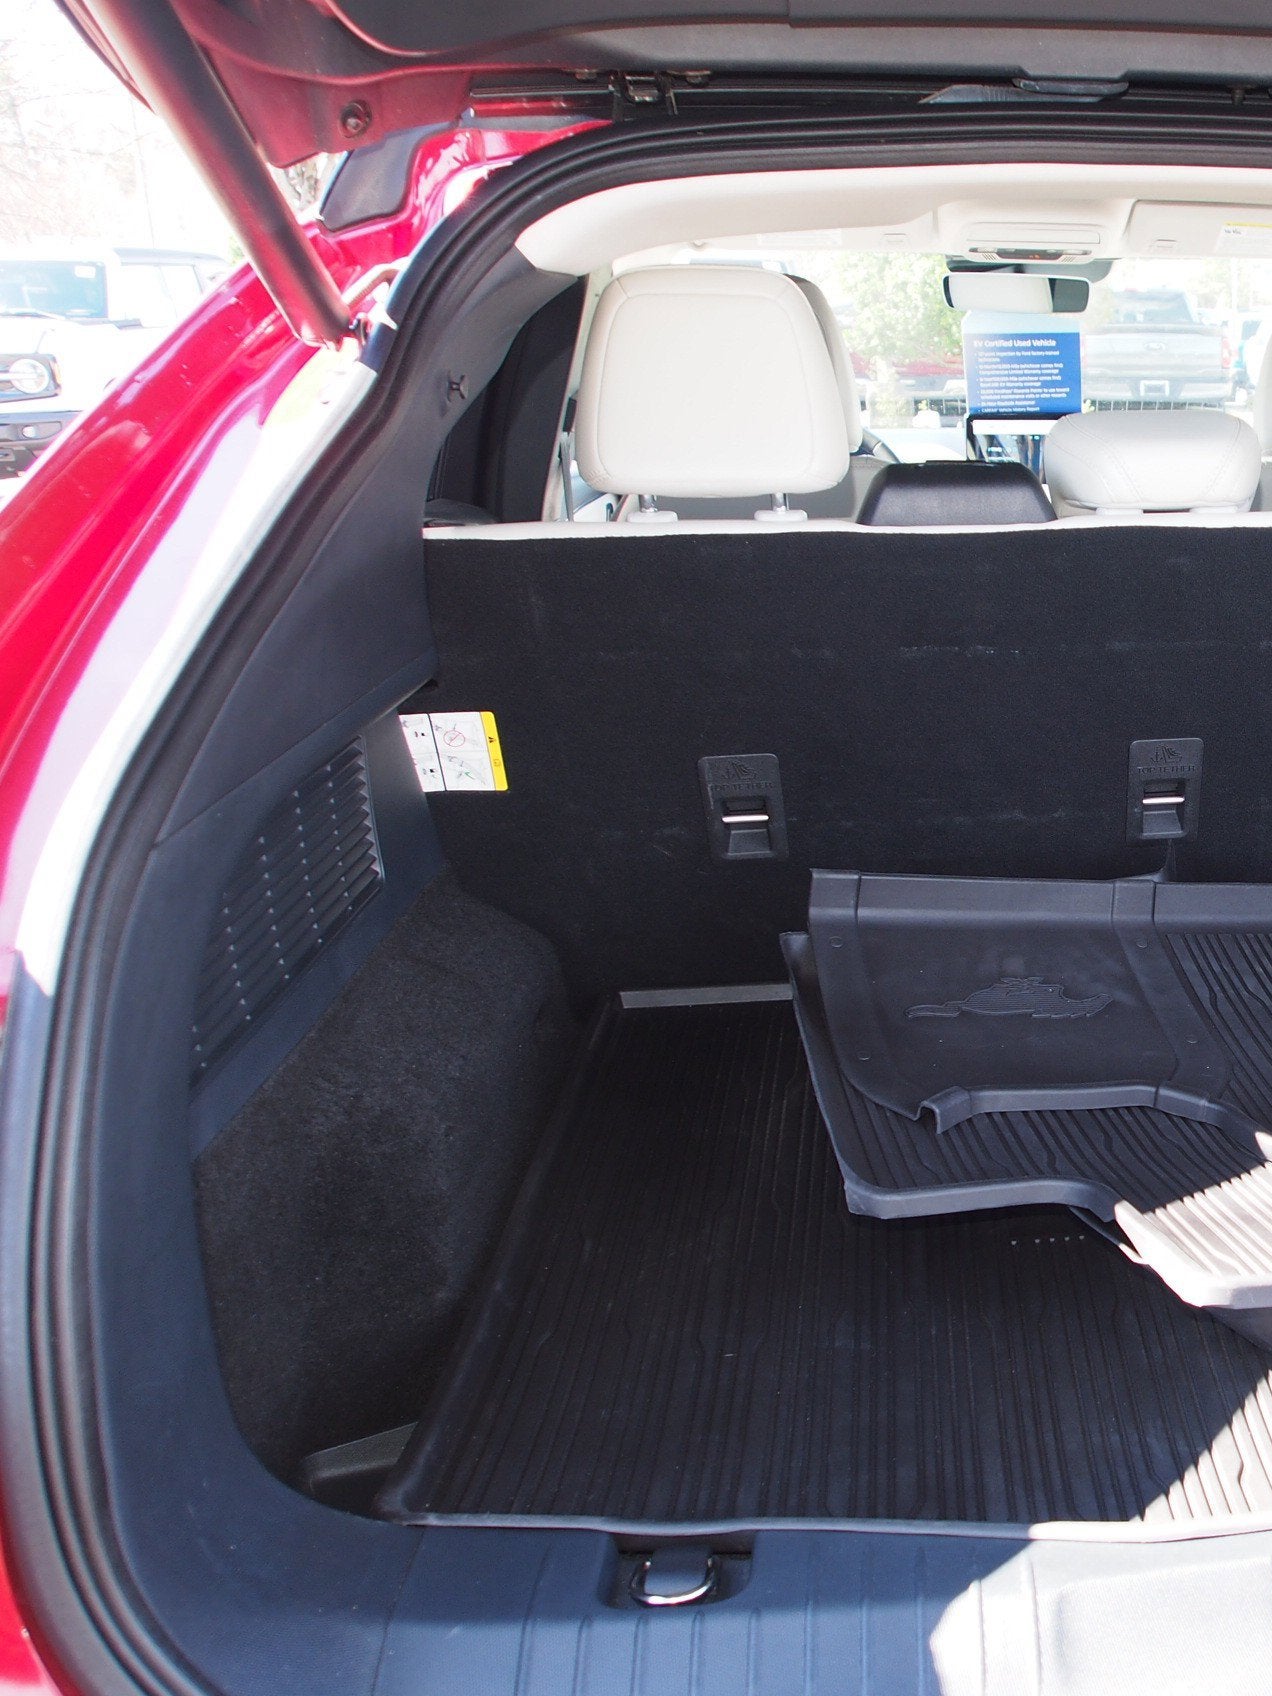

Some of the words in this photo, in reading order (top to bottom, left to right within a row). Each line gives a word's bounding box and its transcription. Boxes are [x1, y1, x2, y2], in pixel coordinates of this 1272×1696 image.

[984, 339, 1013, 347] Certified
[1014, 339, 1031, 347] Used
[1032, 339, 1057, 347] Vehicle
[1137, 766, 1155, 774] TOP
[1159, 765, 1196, 773] TETHER
